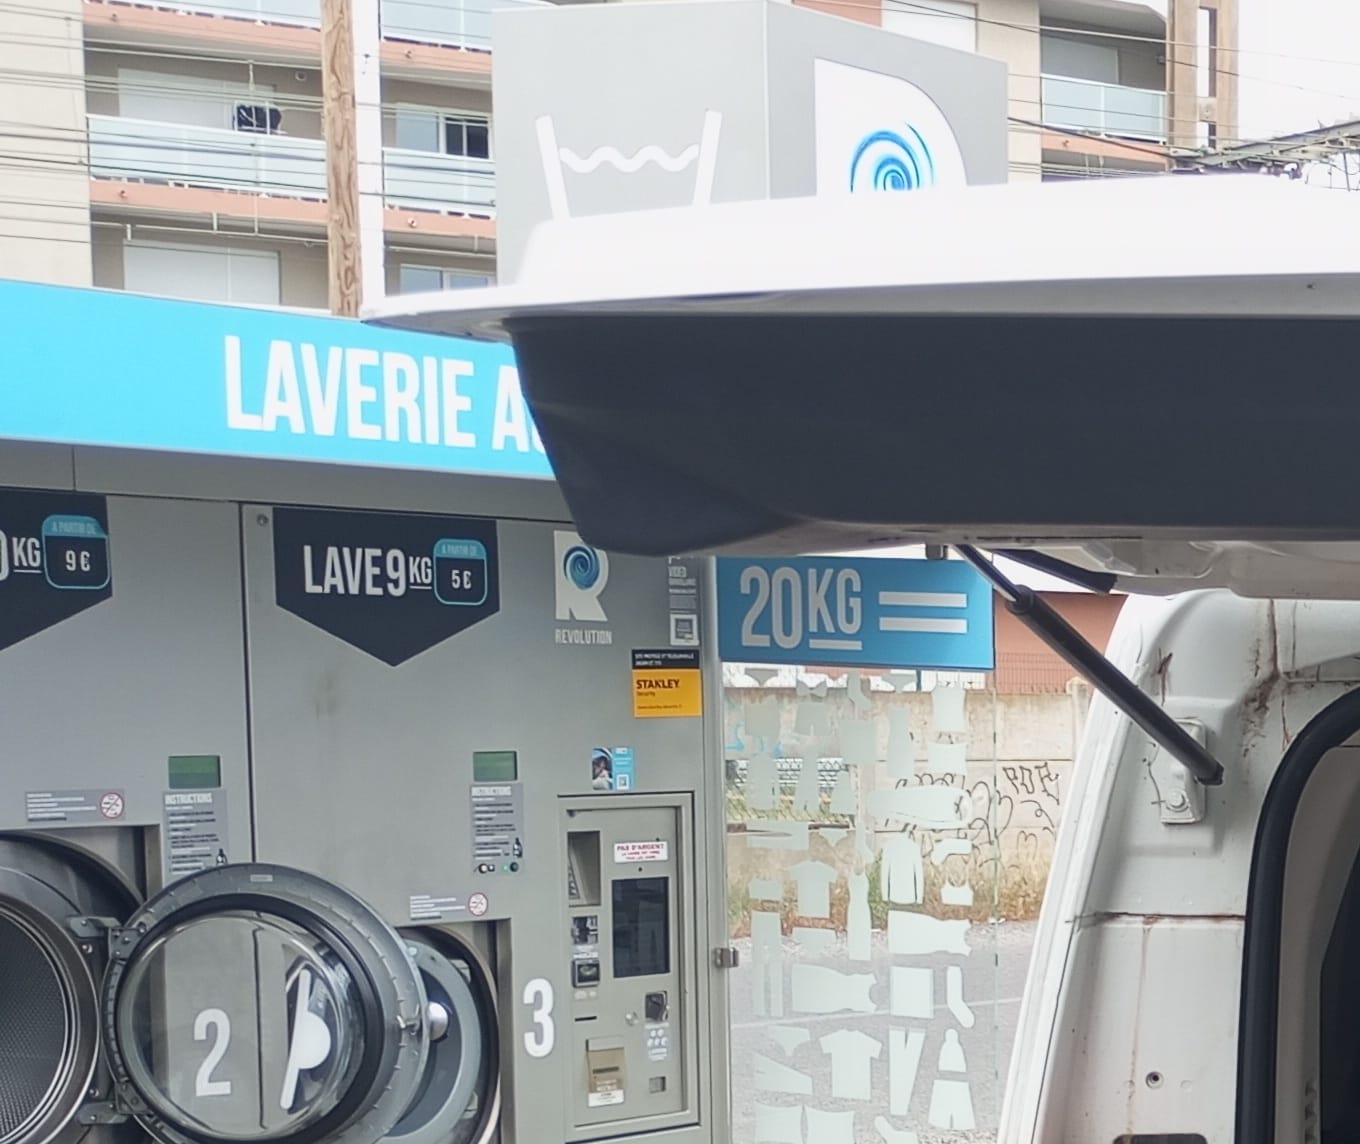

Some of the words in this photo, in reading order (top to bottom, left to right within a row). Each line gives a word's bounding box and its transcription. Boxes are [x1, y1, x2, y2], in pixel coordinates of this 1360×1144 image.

[224, 335, 477, 448] LAVERIE
[491, 364, 548, 455] A
[554, 629, 613, 644] REVOLUTION
[636, 679, 680, 689] STANLEY
[165, 792, 213, 805] INSTRUCTIONS
[523, 978, 555, 1058] 3
[194, 1008, 231, 1096] 2
